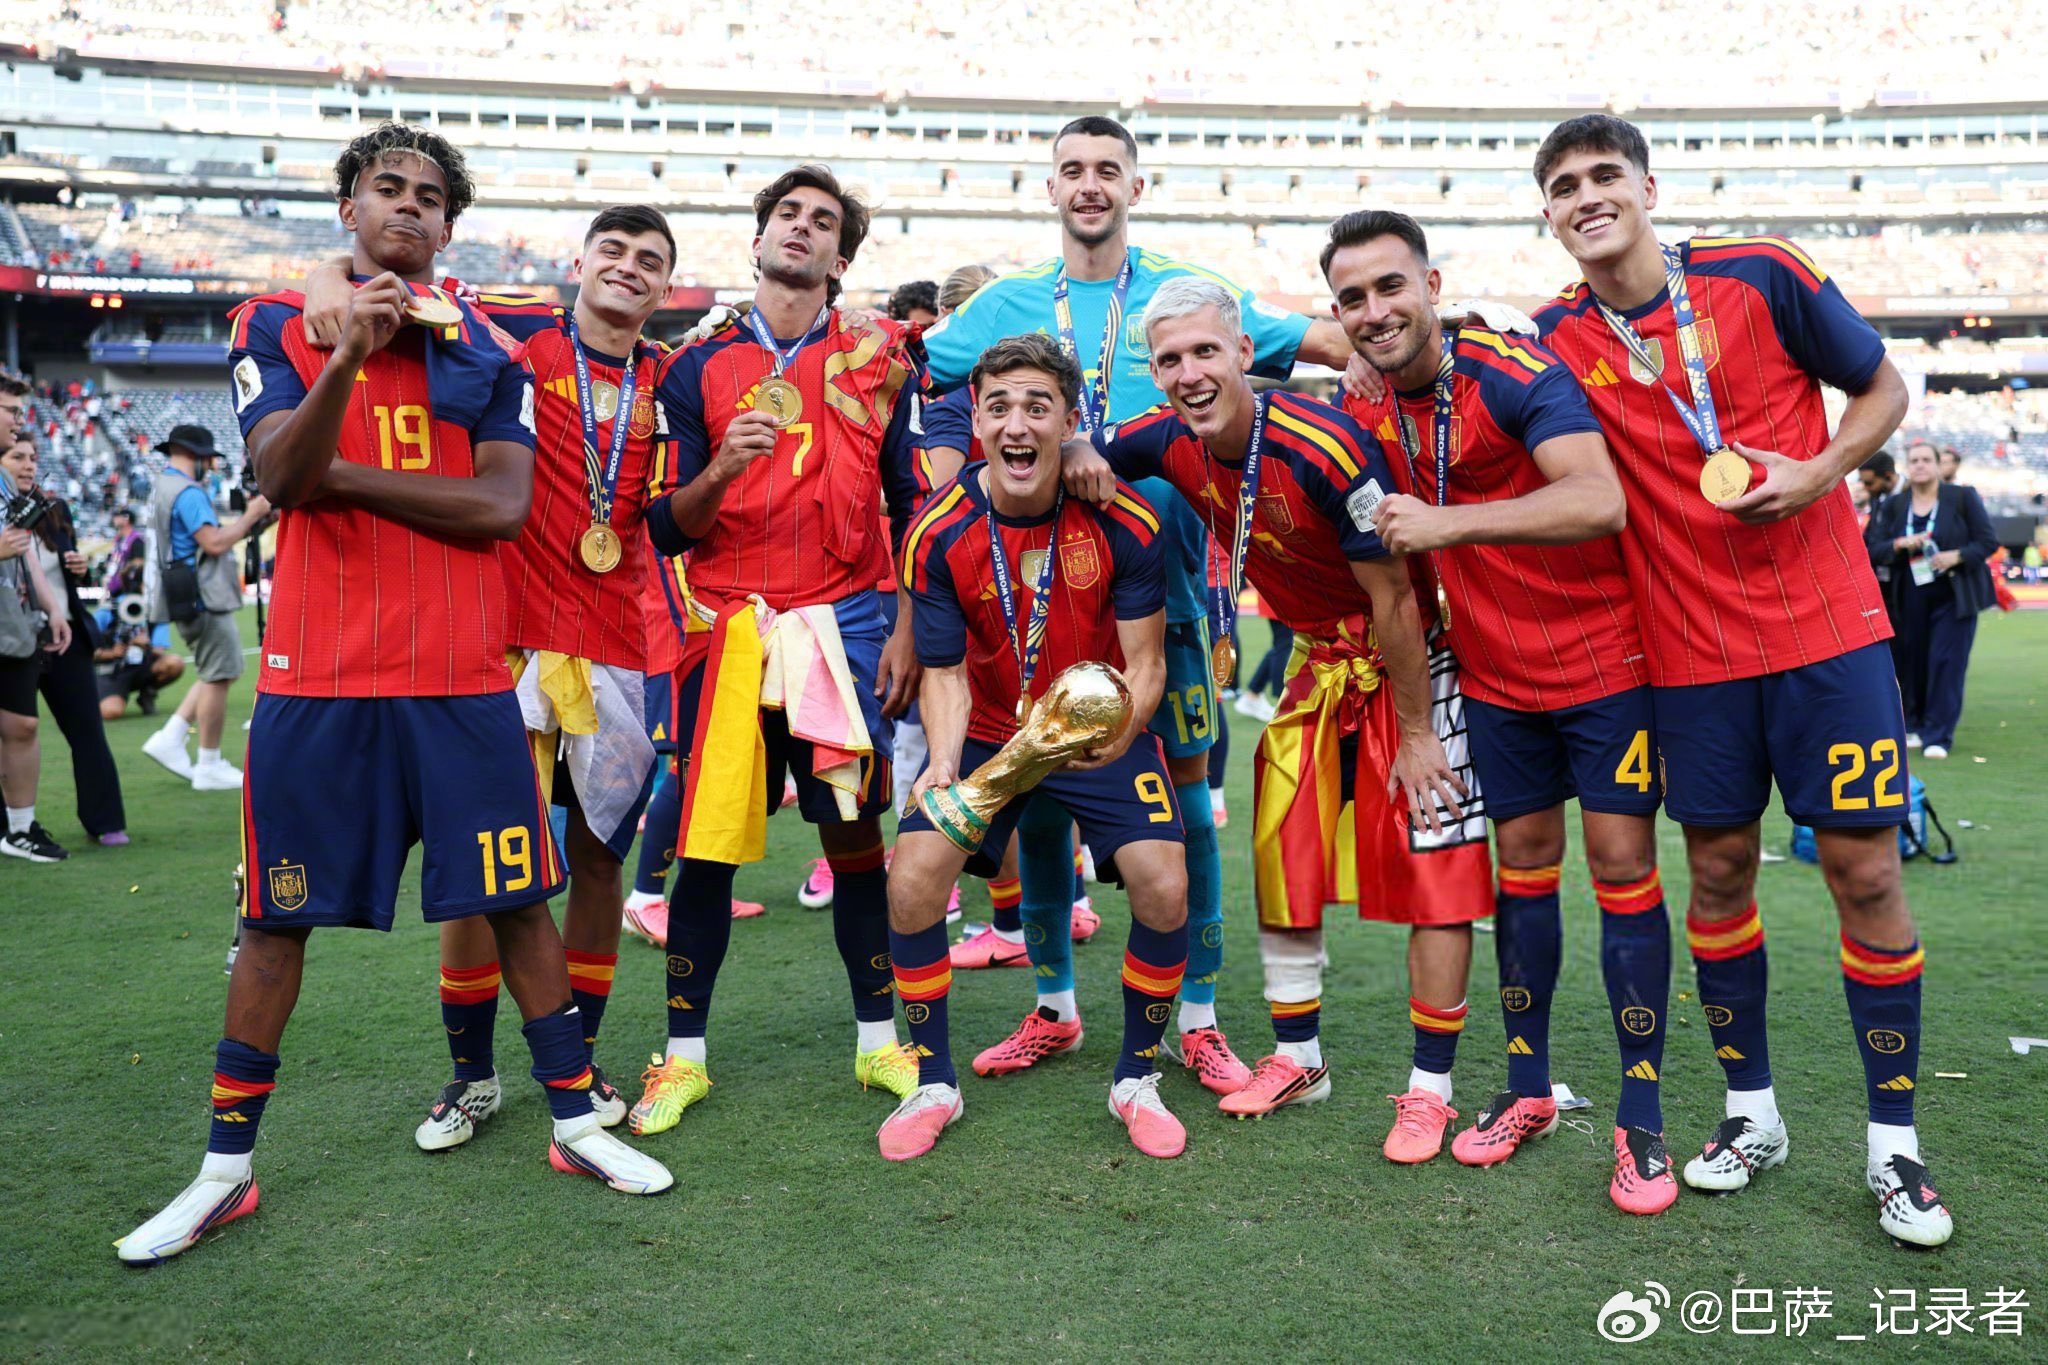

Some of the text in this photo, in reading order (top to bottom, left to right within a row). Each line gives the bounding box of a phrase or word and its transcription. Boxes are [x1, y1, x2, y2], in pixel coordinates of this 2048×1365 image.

[578, 362, 586, 379] CUP
[581, 381, 591, 412] WORLD
[1079, 393, 1090, 422] WORLD
[373, 405, 430, 470] 19
[585, 413, 593, 432] FIFA
[608, 384, 632, 481] FIFA WORLD CUP 2026
[1248, 399, 1263, 474] FIFA WORLD CUP
[1702, 411, 1713, 432] FIFA
[786, 423, 813, 477] 7
[992, 544, 1002, 562] CUP
[997, 563, 1009, 596] WORLD
[1004, 596, 1012, 616] FIFA
[1168, 684, 1209, 744] 13
[1615, 730, 1652, 793] 4
[1827, 739, 1904, 810] 22
[1134, 771, 1174, 823] 9
[477, 826, 531, 896] 19
[1506, 992, 1523, 1000] RF
[1628, 1012, 1648, 1021] RF
[1630, 1020, 1648, 1029] EF
